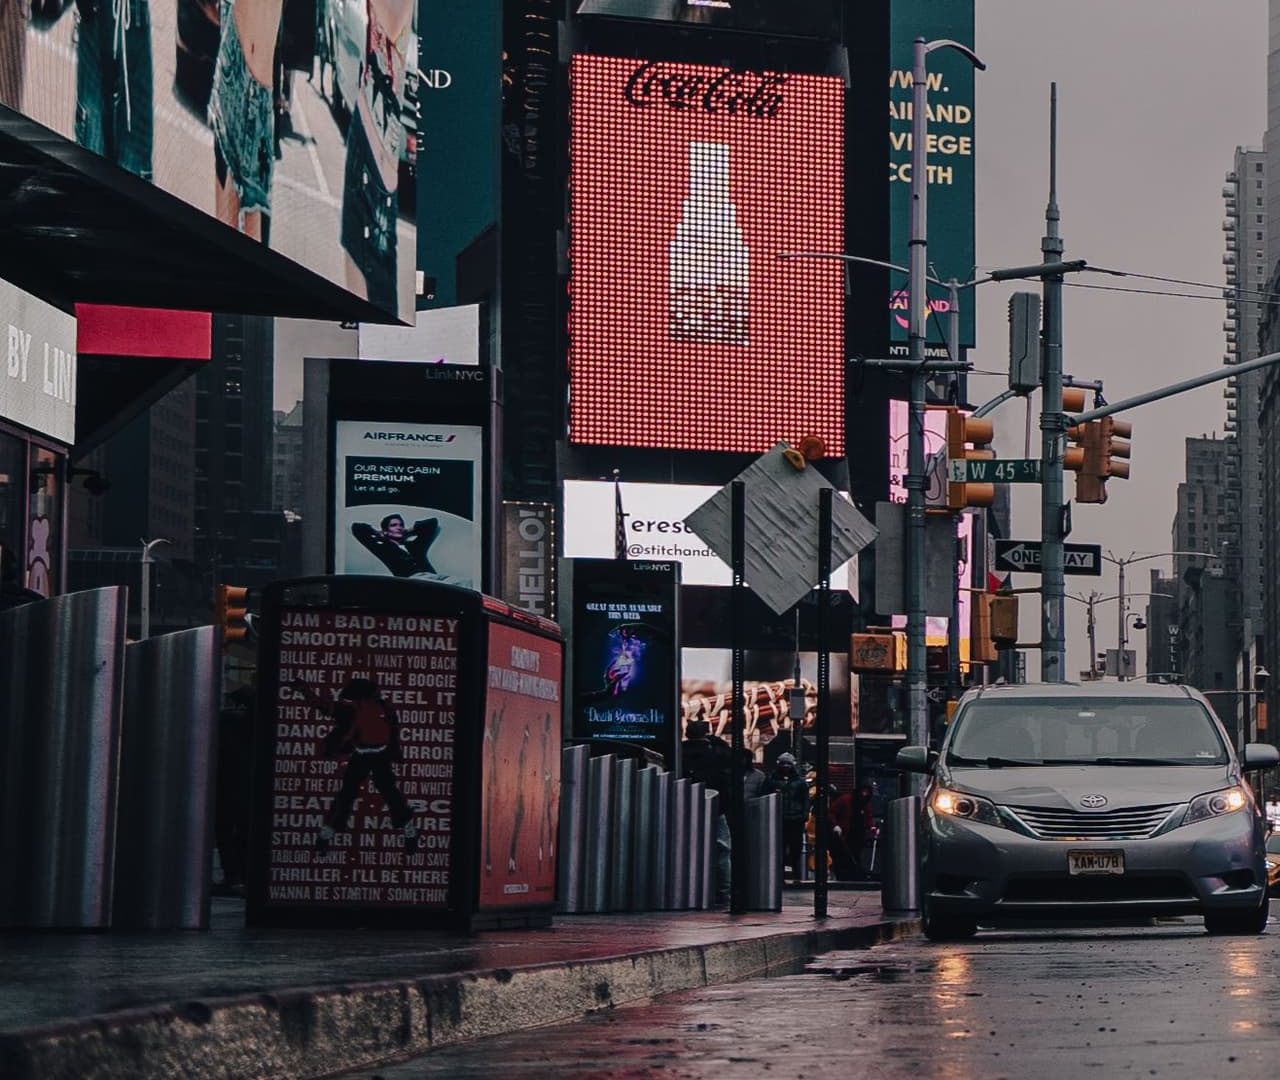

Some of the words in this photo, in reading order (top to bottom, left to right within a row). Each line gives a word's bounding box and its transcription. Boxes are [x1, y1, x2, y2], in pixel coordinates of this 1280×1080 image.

[7, 323, 32, 383] BY
[353, 463, 378, 474] OUR
[379, 464, 405, 475] NEW
[406, 465, 441, 476] CABIN
[970, 462, 987, 480] W
[994, 461, 1016, 481] 45
[518, 508, 546, 617] HELLO!
[1011, 549, 1042, 564] ONE
[1063, 553, 1088, 566] AY
[280, 612, 321, 628] JAM
[334, 614, 377, 630] BAD
[387, 616, 459, 633] MONEY
[280, 631, 362, 647] SMOOTH
[366, 634, 458, 652] CRIMINAL
[279, 650, 317, 665] BILLIE
[320, 652, 353, 667] JEAN
[373, 655, 405, 669] WANT
[406, 656, 428, 670] YOU
[278, 668, 327, 684] BLAME
[331, 670, 346, 684] IT
[375, 672, 403, 687] THE
[407, 673, 457, 688] BOOGIE
[379, 689, 429, 705] FEEL
[436, 691, 457, 706] IT
[277, 705, 312, 721] THEY
[438, 711, 456, 726] US
[275, 741, 316, 757] MAN
[308, 760, 339, 776] STOP
[410, 763, 453, 779] ENOUGH
[273, 777, 301, 792] KEEP
[303, 778, 325, 793] THE
[402, 781, 418, 795] OR
[420, 781, 453, 797] WHITE
[273, 795, 336, 811] BEAT
[359, 833, 376, 847] IN
[271, 849, 311, 865] TABLOID
[359, 851, 377, 865] THE
[379, 851, 404, 866] LOVE
[426, 852, 451, 868] SAVE
[271, 867, 342, 883] THRILLER
[351, 869, 377, 884] I'LL
[380, 870, 400, 884] BE
[403, 870, 450, 886] THERE
[269, 885, 312, 900] WANNA
[314, 886, 330, 901] BE
